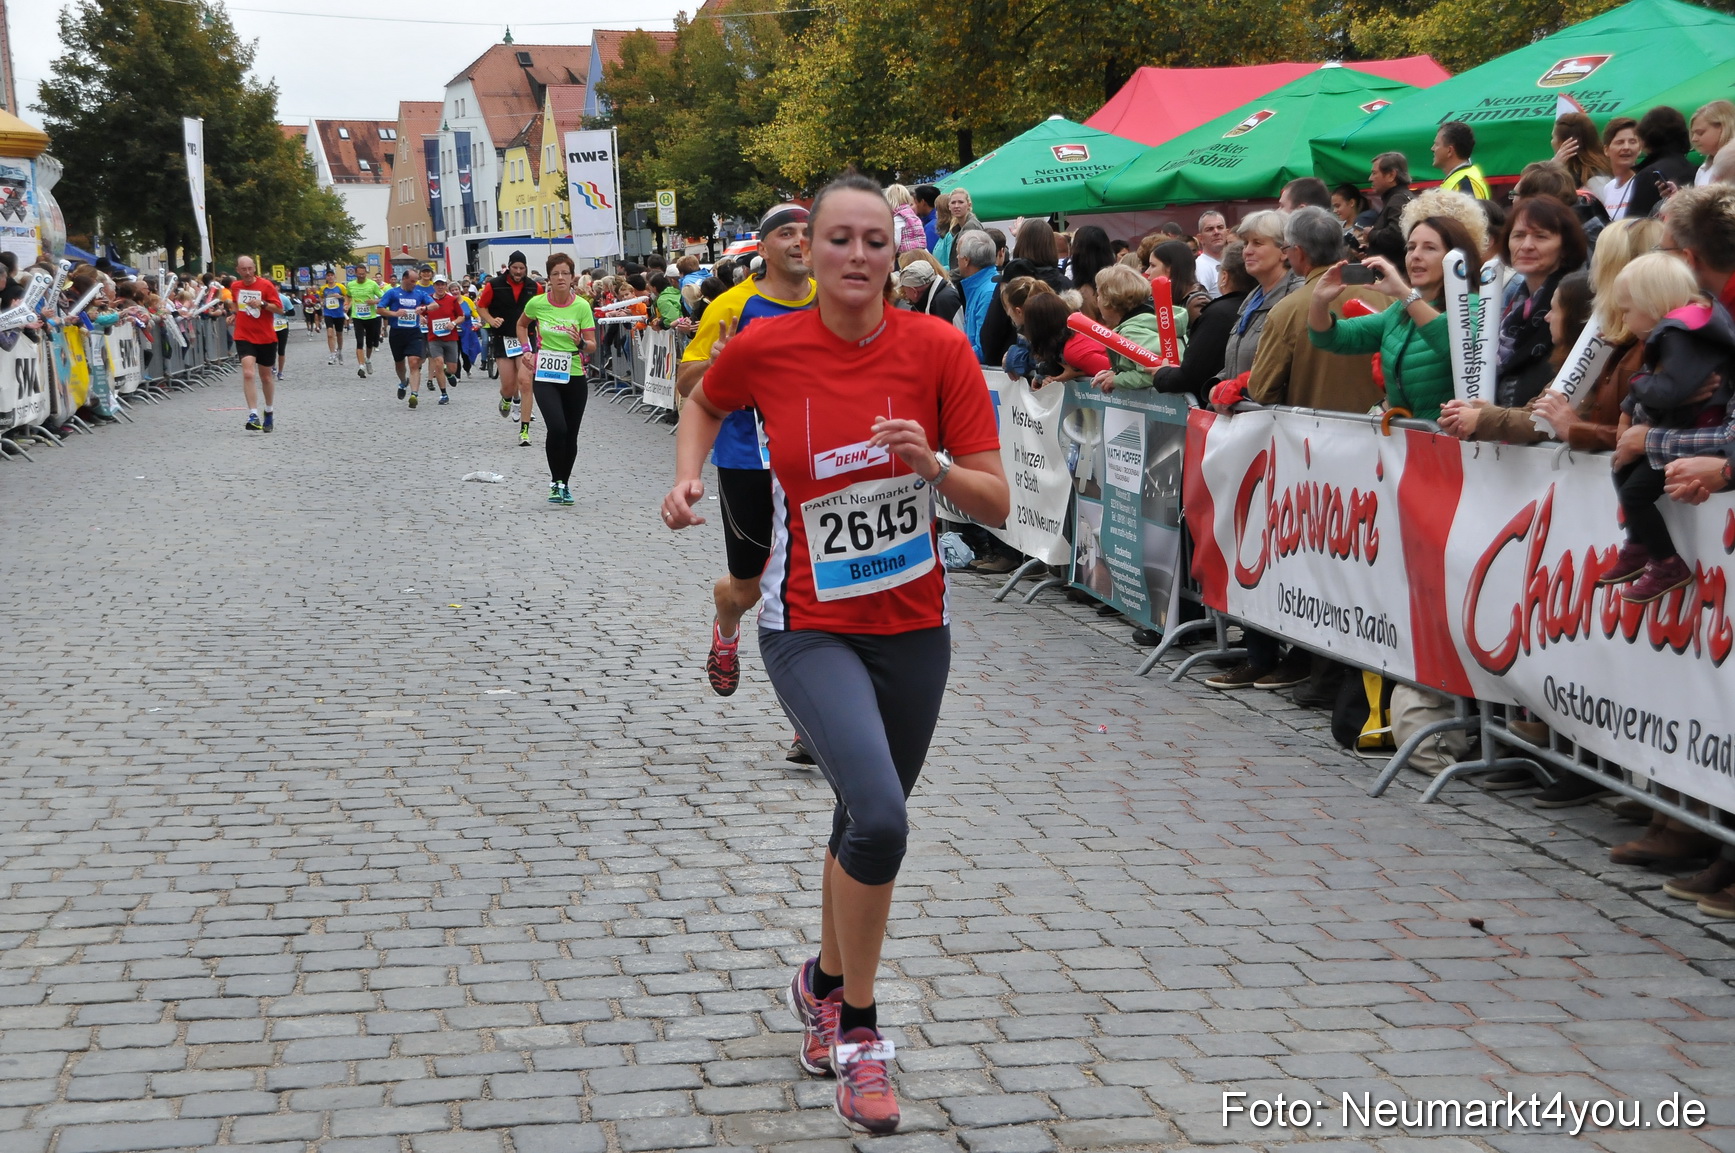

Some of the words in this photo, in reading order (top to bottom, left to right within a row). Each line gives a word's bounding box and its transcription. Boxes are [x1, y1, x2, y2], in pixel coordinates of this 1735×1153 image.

[1436, 101, 1621, 125] Lammsbäu
[1117, 337, 1137, 351] BKK
[1137, 348, 1159, 362] Audi
[1164, 337, 1174, 358] BKK
[540, 357, 568, 371] 2803
[836, 449, 868, 467] DEHN
[1122, 450, 1142, 466] HOFFER
[804, 495, 847, 512] PARTL
[850, 485, 909, 504] Neumarkt
[1234, 435, 1384, 589] Charivari
[820, 495, 918, 555] 2645
[850, 554, 906, 580] Bettina
[1277, 582, 1350, 635] Ostbayerns
[1354, 605, 1398, 650] Radio
[1543, 674, 1680, 755] Ostbayerns
[1686, 718, 1735, 778] Rad
